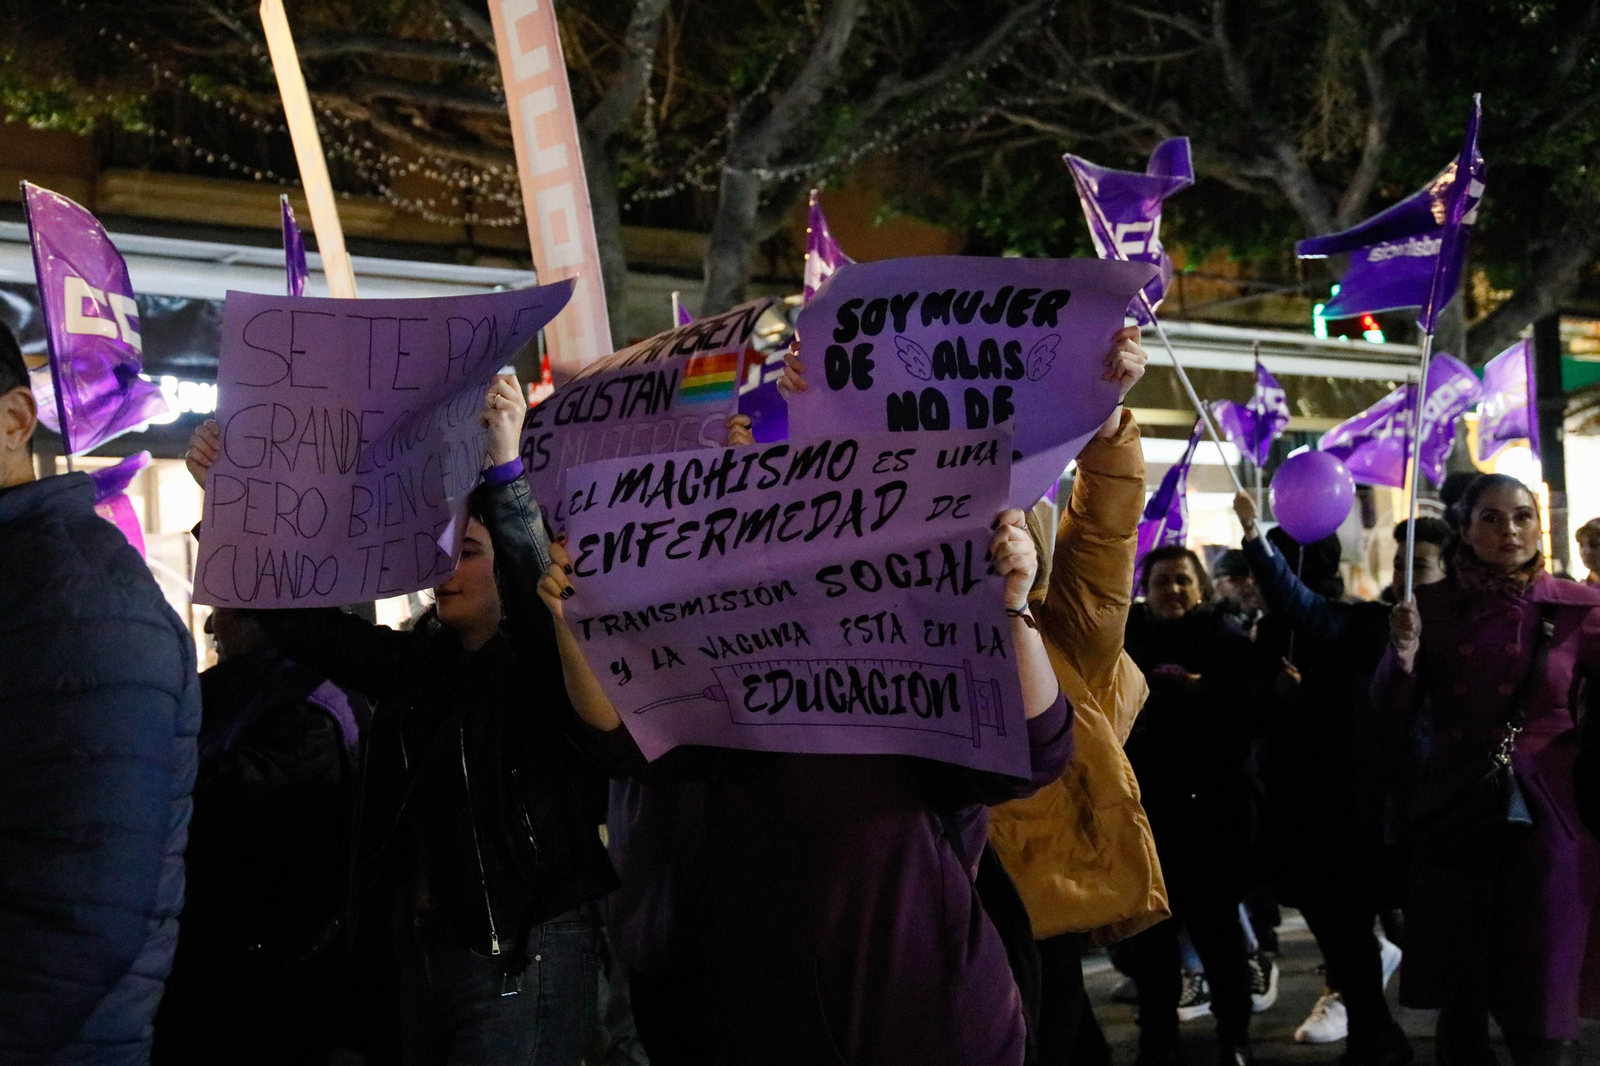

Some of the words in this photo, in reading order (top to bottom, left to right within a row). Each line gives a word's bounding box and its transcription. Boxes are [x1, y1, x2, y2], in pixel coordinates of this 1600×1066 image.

[833, 291, 919, 344] SOY
[921, 286, 1071, 329] MUJER
[236, 309, 336, 389] SE
[346, 315, 428, 390] TE
[824, 342, 875, 391] DE
[932, 336, 1026, 381] ALAS
[554, 368, 679, 427] GUSTAN
[886, 386, 950, 433] NO
[224, 403, 384, 475] GRANDE
[213, 474, 327, 539] PERO
[348, 472, 417, 538] BIEN
[569, 481, 599, 515] EL
[607, 438, 859, 511] MACHISMO
[872, 448, 916, 474] ES
[203, 545, 338, 602] CUANDO
[357, 538, 405, 594] TE
[414, 519, 456, 584] DE
[572, 480, 908, 578] ENFERMEDAD
[925, 494, 972, 523] DE
[815, 540, 982, 597] SOCIAL
[651, 647, 686, 671] LA
[840, 604, 908, 648] ESTÁ
[974, 622, 1007, 660] LA
